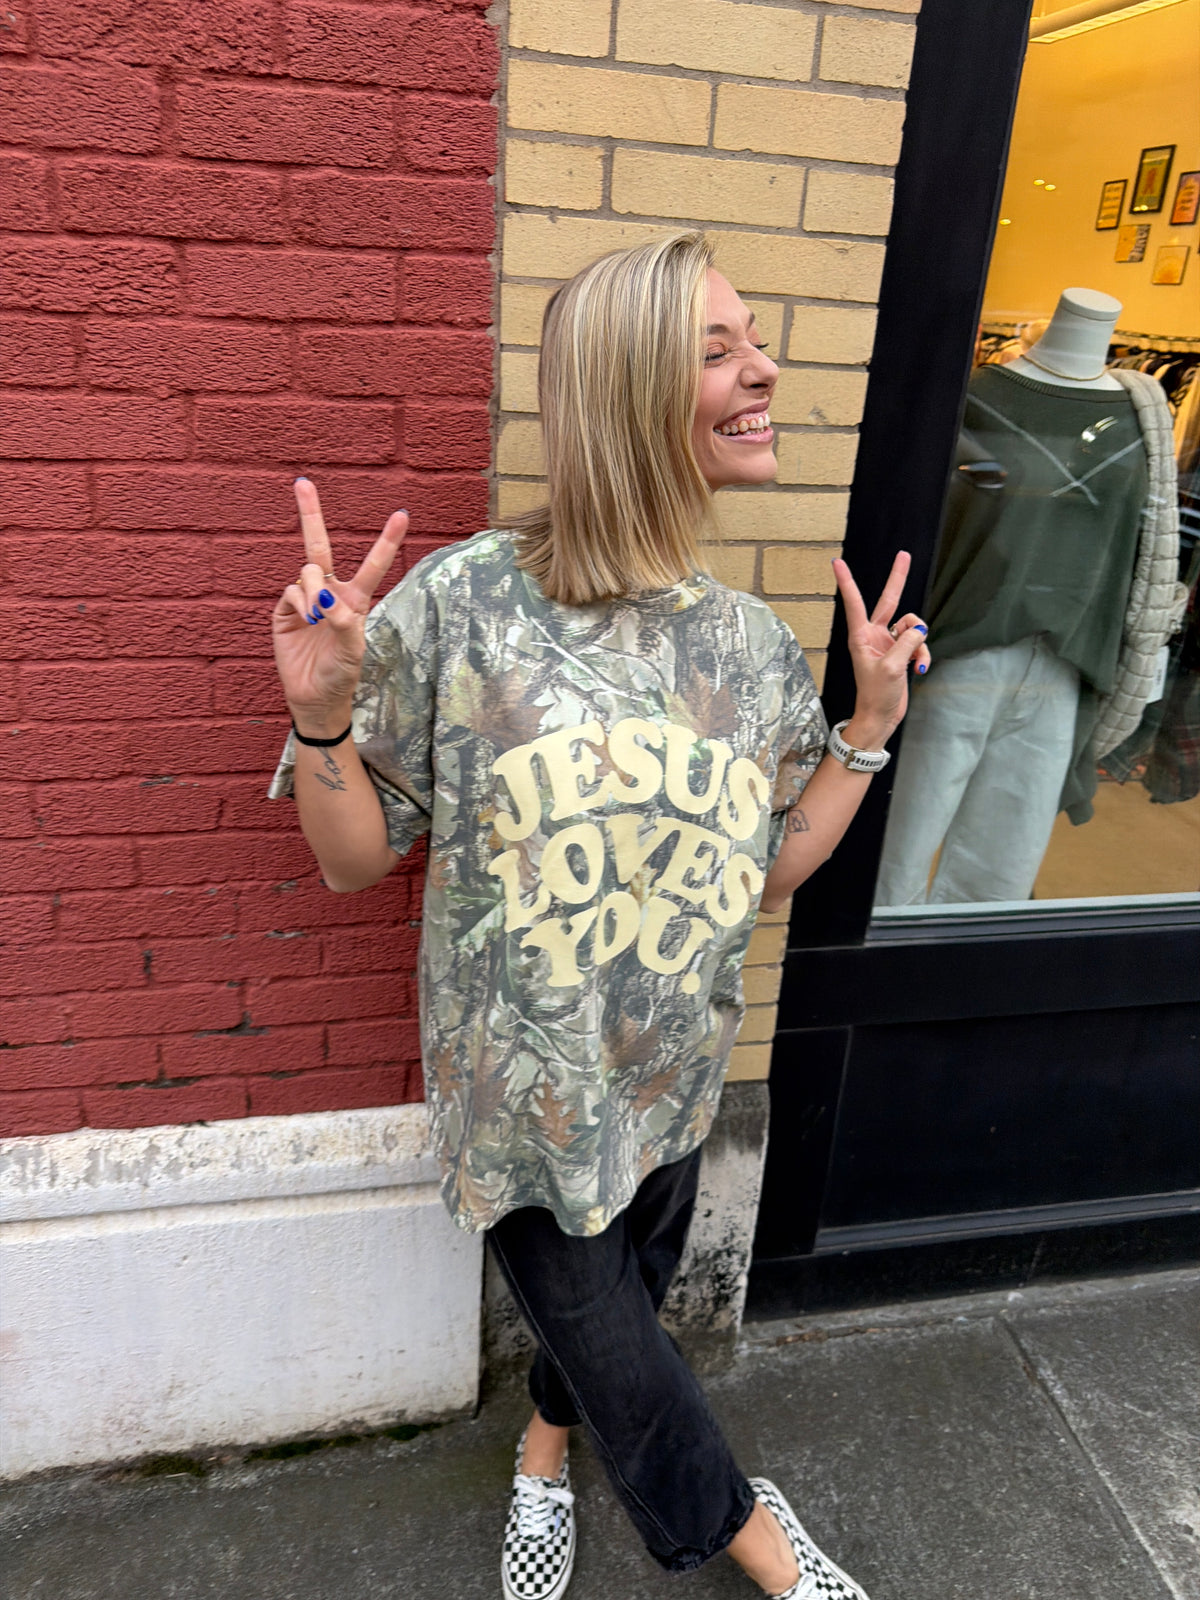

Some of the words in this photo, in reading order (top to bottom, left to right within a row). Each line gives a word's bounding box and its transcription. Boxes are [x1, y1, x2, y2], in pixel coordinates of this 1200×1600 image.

[492, 718, 769, 841] JESUS
[488, 814, 764, 932] LOVES
[520, 891, 714, 994] YOU.
